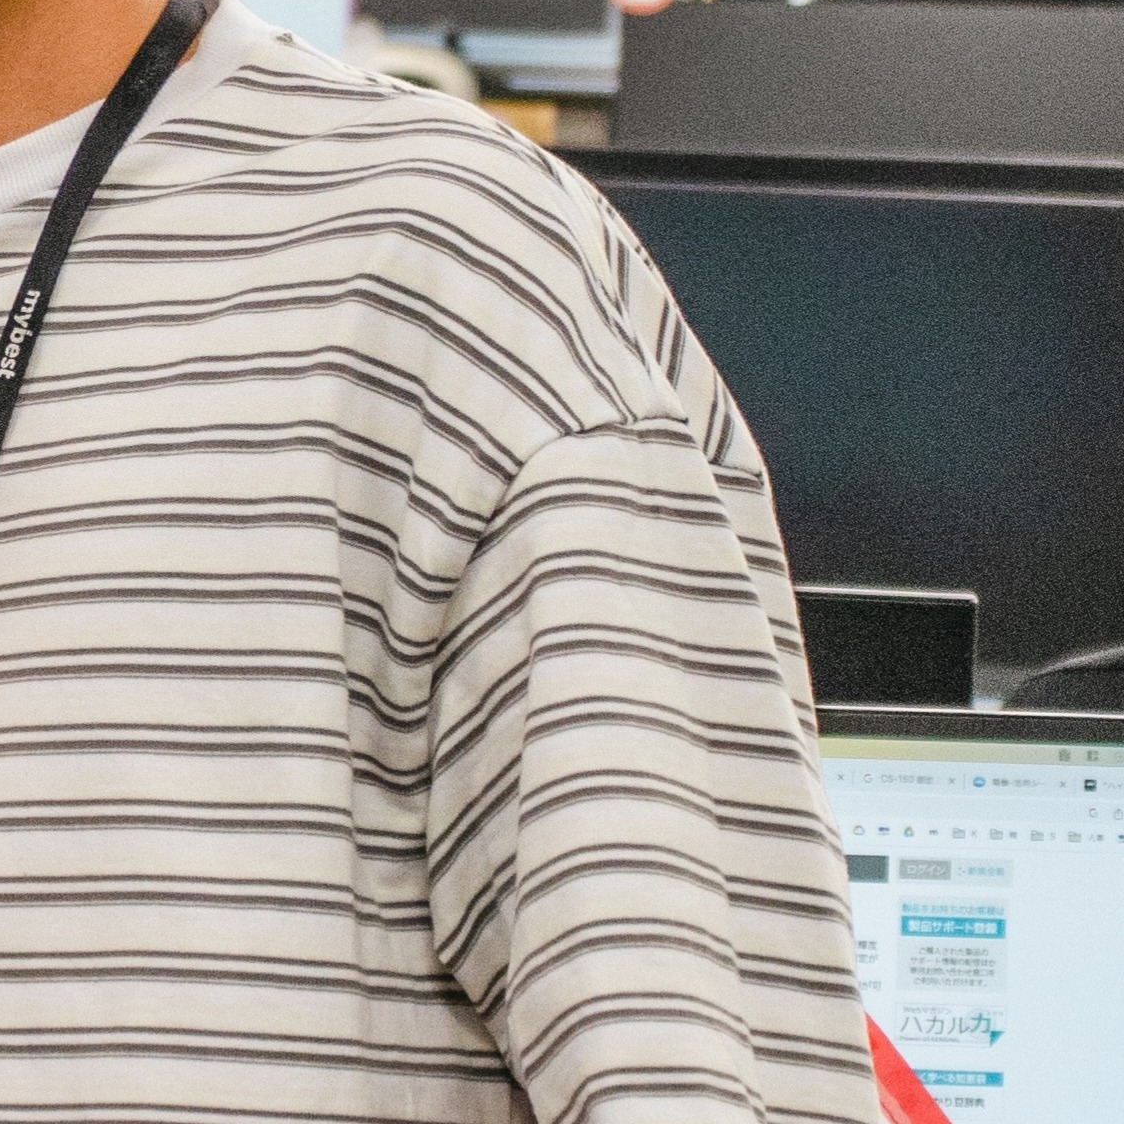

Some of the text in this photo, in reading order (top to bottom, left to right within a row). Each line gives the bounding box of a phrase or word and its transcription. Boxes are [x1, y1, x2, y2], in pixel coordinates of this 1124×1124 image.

[907, 864, 946, 876] ログイン
[908, 920, 997, 935] 製品サポート登録
